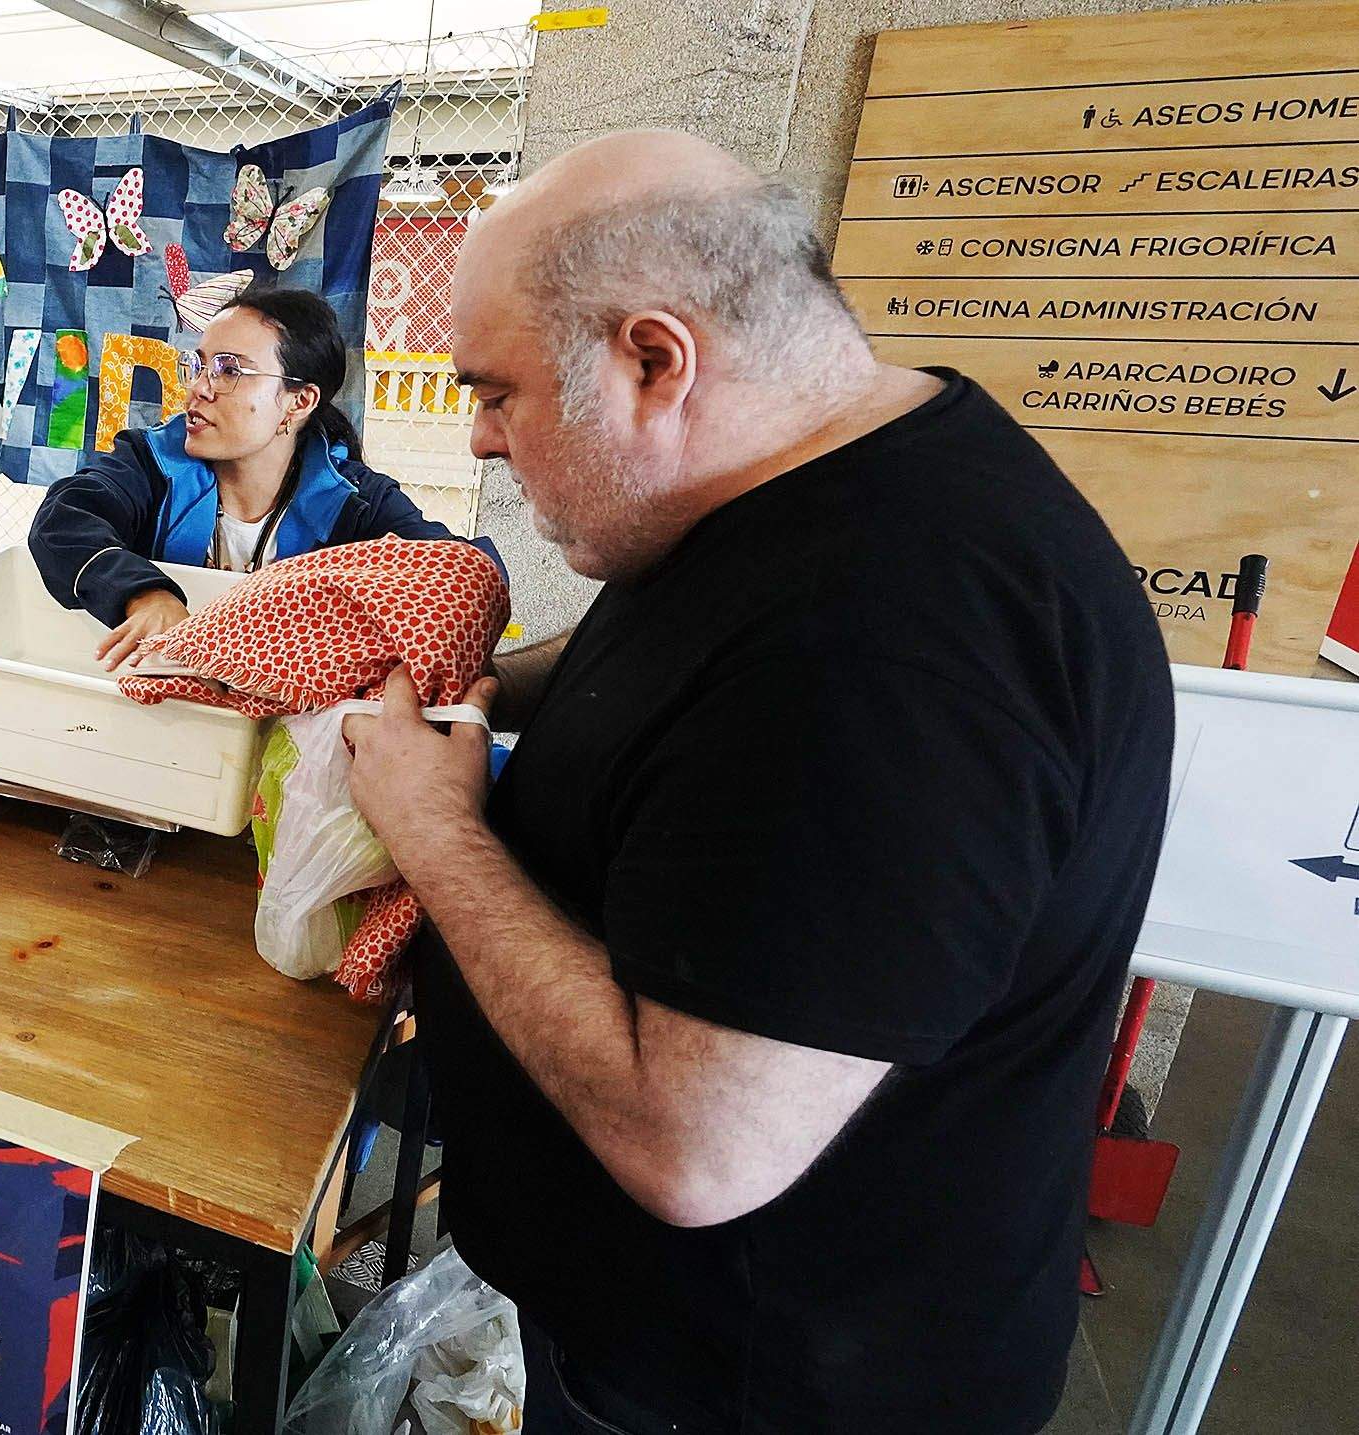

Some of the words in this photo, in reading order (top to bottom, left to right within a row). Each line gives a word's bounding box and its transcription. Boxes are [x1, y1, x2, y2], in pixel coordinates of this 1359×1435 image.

[1132, 103, 1244, 126] ASEOS
[935, 175, 1102, 197] ASCENSOR
[1155, 166, 1359, 193] ESCALEIRAS
[960, 238, 1121, 258] CONSIGNA
[1130, 231, 1337, 256] FRIGORÍFICA
[914, 299, 1030, 318] OFICINA
[1038, 296, 1318, 322] ADMINISTRACIÓN
[1064, 362, 1296, 386] APARCADOIRO
[1022, 390, 1176, 414] CARRIÑOS
[1184, 394, 1287, 418] BEBÉS
